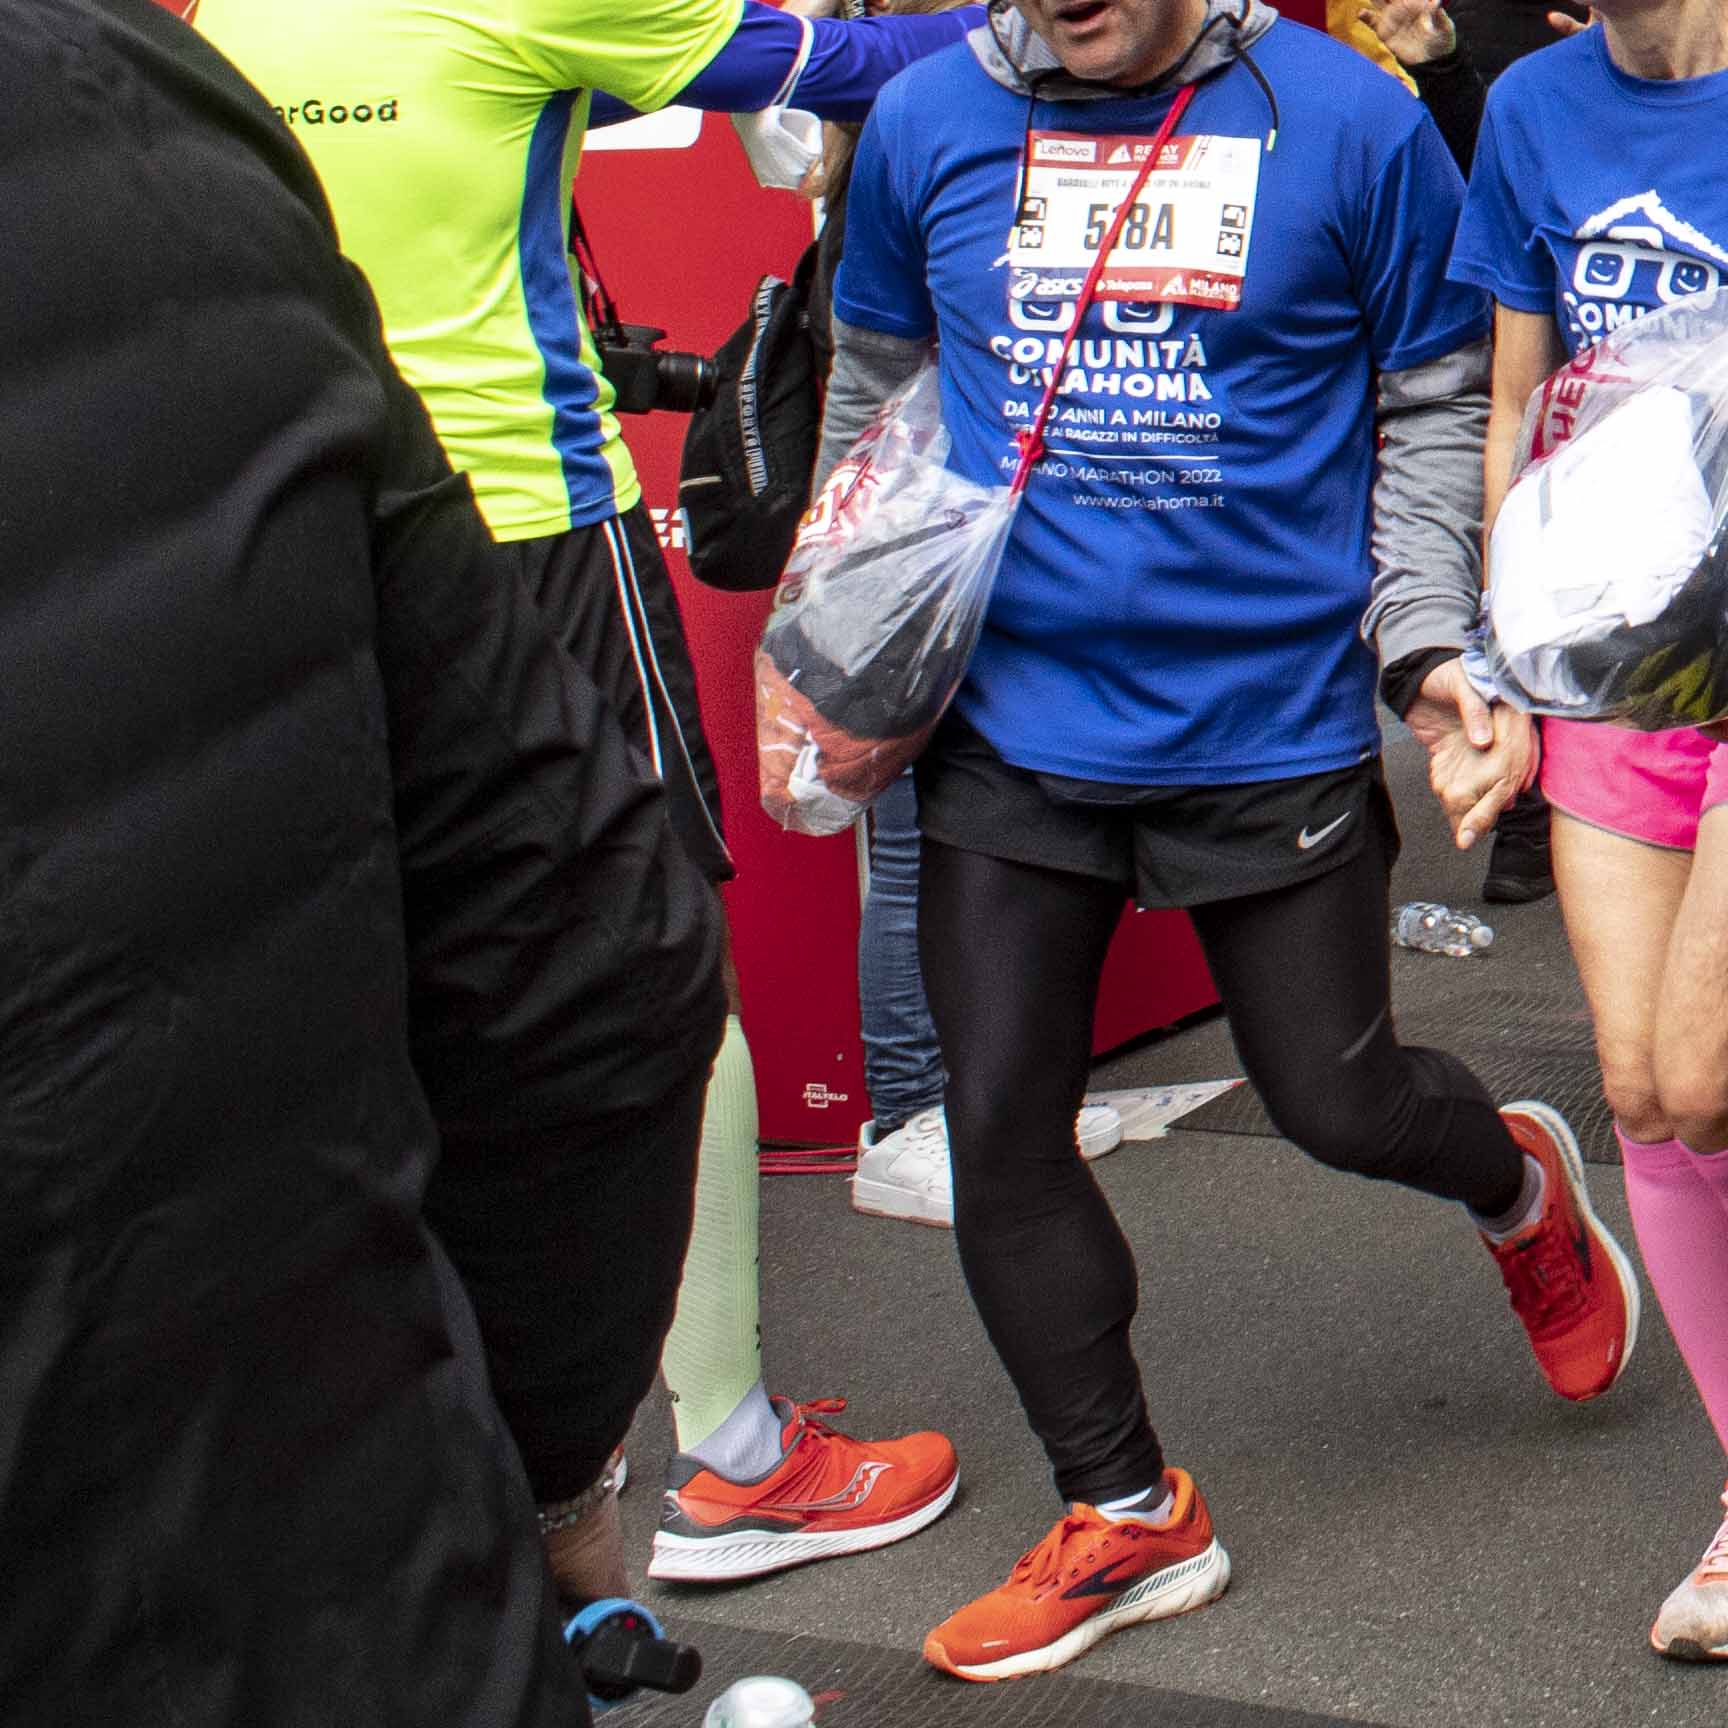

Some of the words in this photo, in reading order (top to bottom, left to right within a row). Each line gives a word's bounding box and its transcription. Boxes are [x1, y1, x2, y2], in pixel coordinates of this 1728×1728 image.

[1134, 144, 1180, 157] REAY
[989, 333, 1208, 370] COMUNITÀ
[1003, 400, 1030, 418] DA
[1060, 407, 1105, 425] ANNI
[1110, 409, 1127, 425] A
[1132, 408, 1222, 429] MILANO
[1001, 455, 1068, 477] MANO
[1180, 468, 1224, 485] 2022
